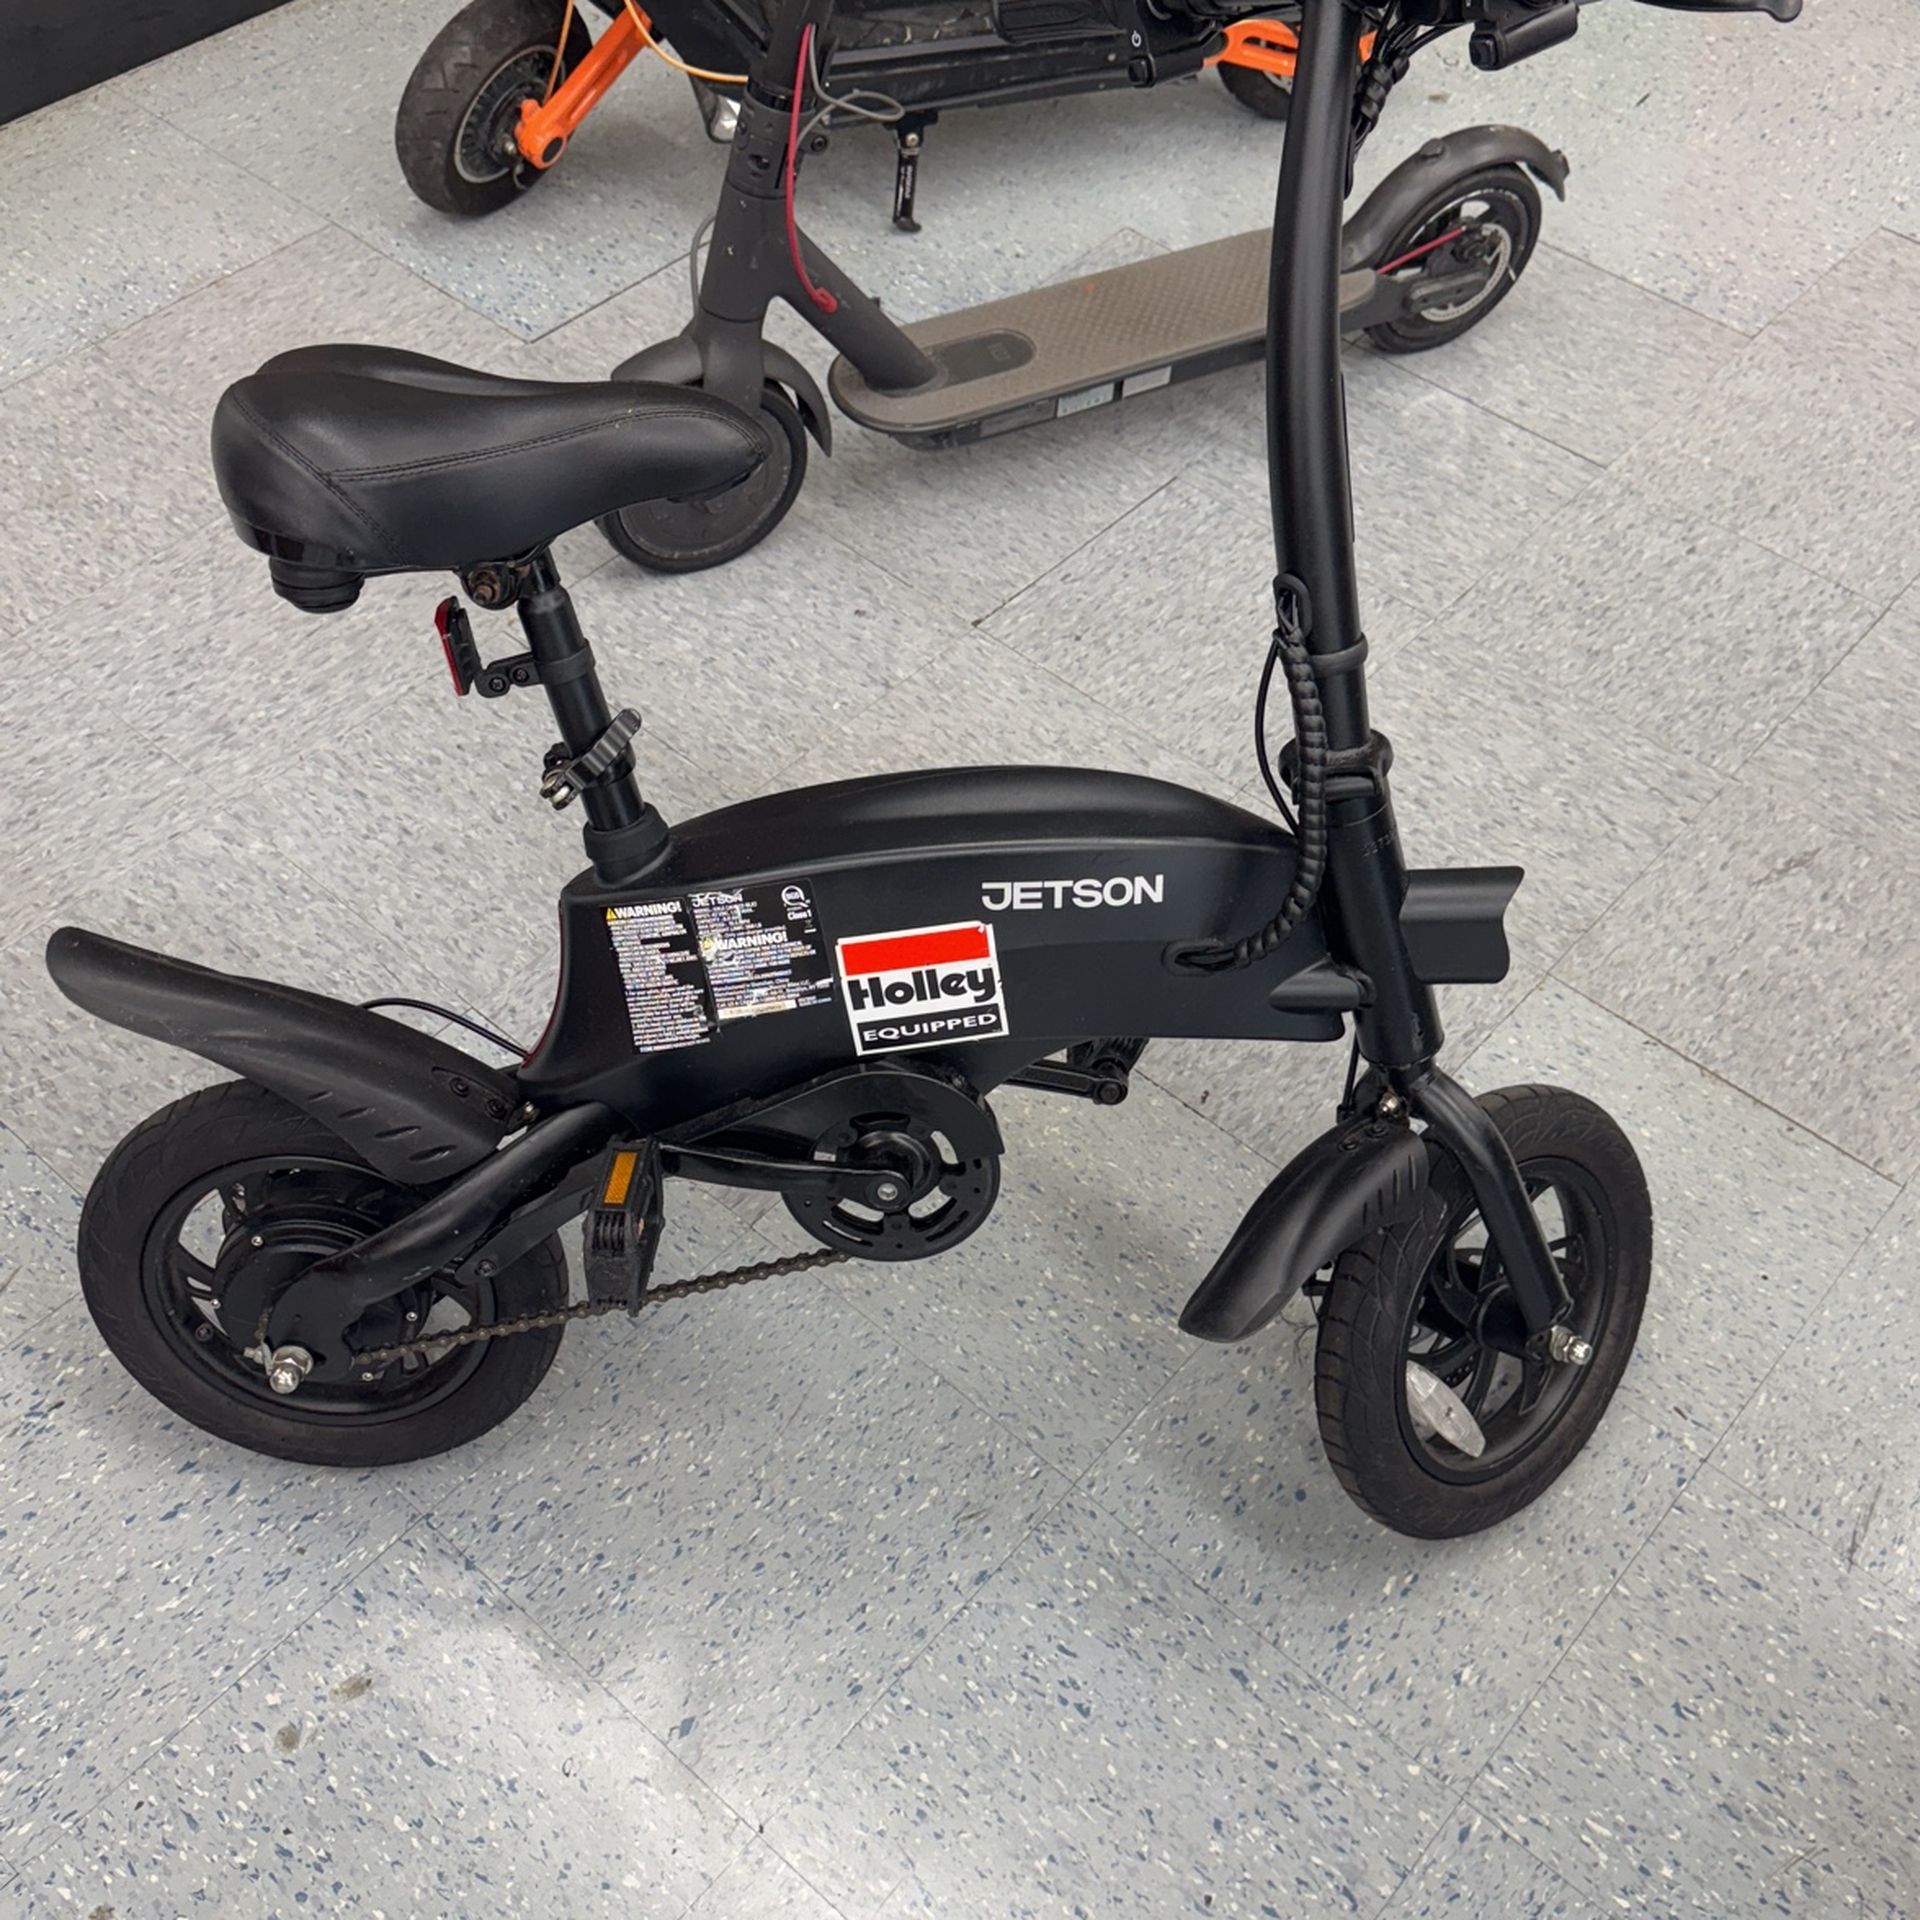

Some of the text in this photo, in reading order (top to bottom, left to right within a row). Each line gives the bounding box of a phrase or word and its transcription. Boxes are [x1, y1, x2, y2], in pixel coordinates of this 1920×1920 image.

[981, 874, 1164, 911] JETSON
[613, 901, 682, 919] WARNING!
[787, 911, 807, 920] Class
[715, 931, 788, 951] WARNING!
[847, 967, 997, 1011] Holley
[862, 1012, 998, 1043] EQUIPPED
